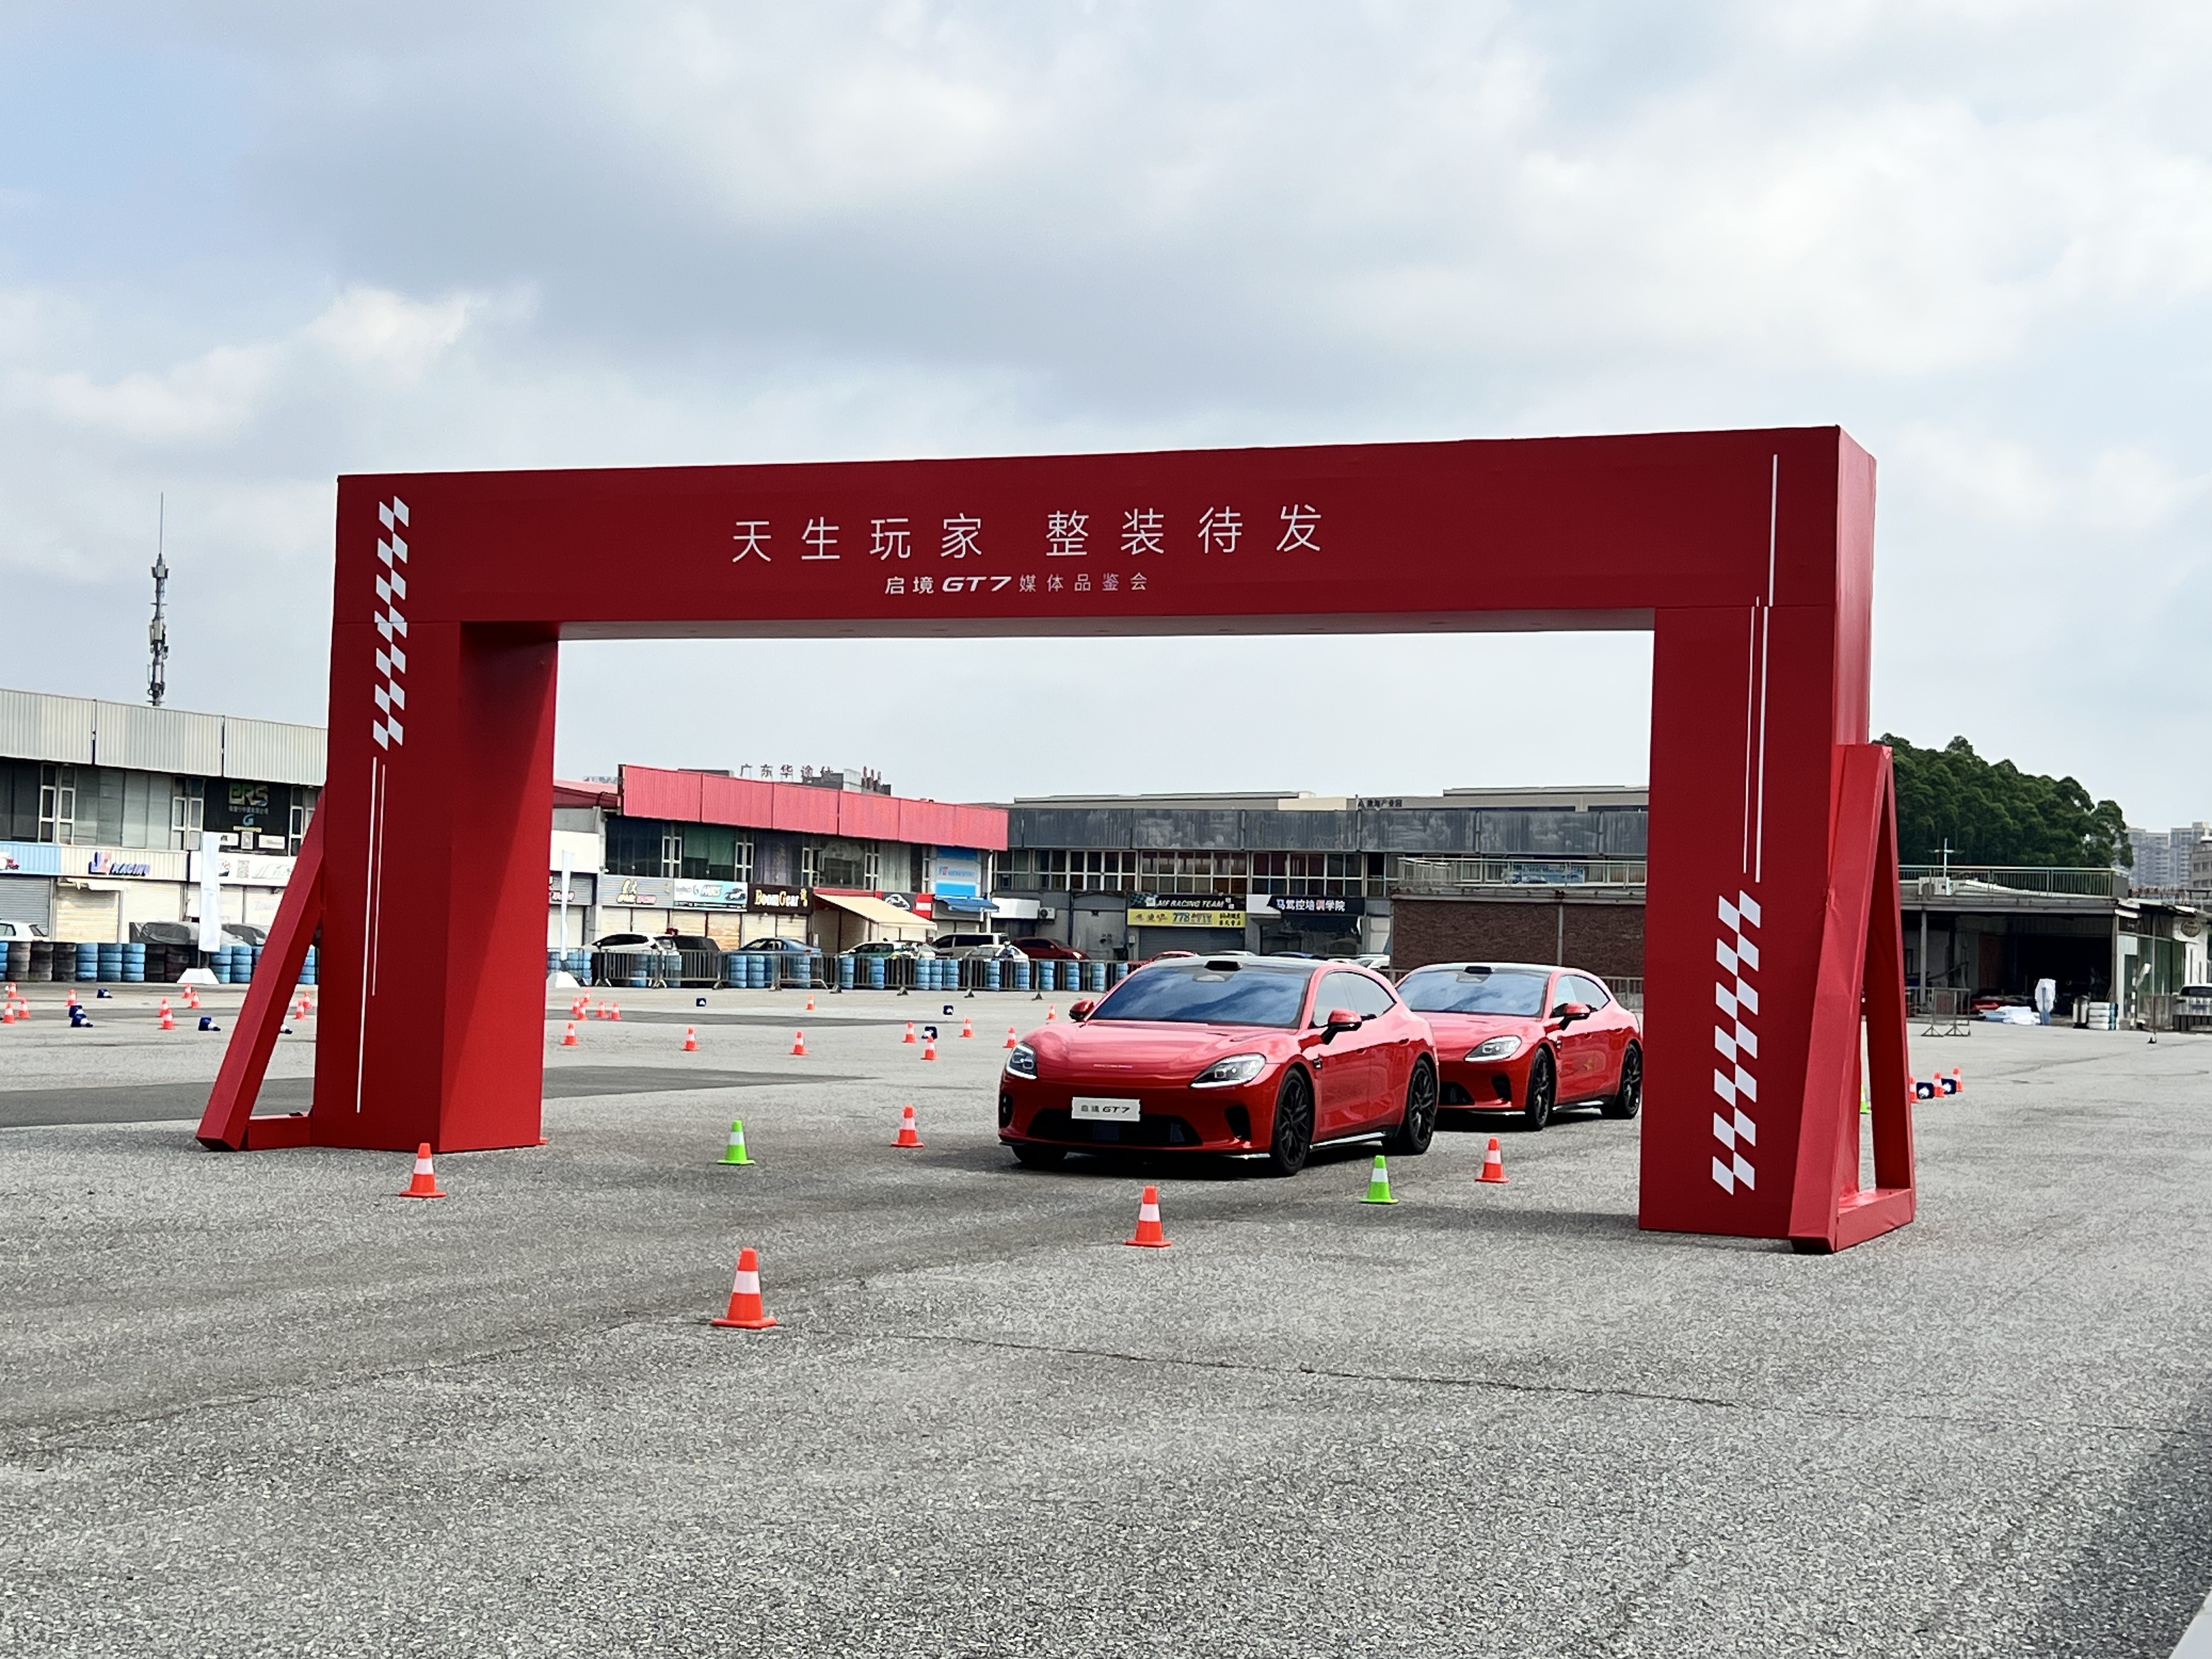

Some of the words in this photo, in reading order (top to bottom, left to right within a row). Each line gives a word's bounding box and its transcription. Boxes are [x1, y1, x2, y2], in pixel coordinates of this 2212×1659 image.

[732, 512, 983, 563] 天生玩家
[1045, 504, 1322, 556] 整装待发
[884, 576, 934, 595] 启境
[941, 576, 1012, 592] GT7
[1019, 572, 1148, 593] 媒体品鉴会
[754, 889, 799, 907] BoomGear
[1170, 899, 1201, 907] RACING
